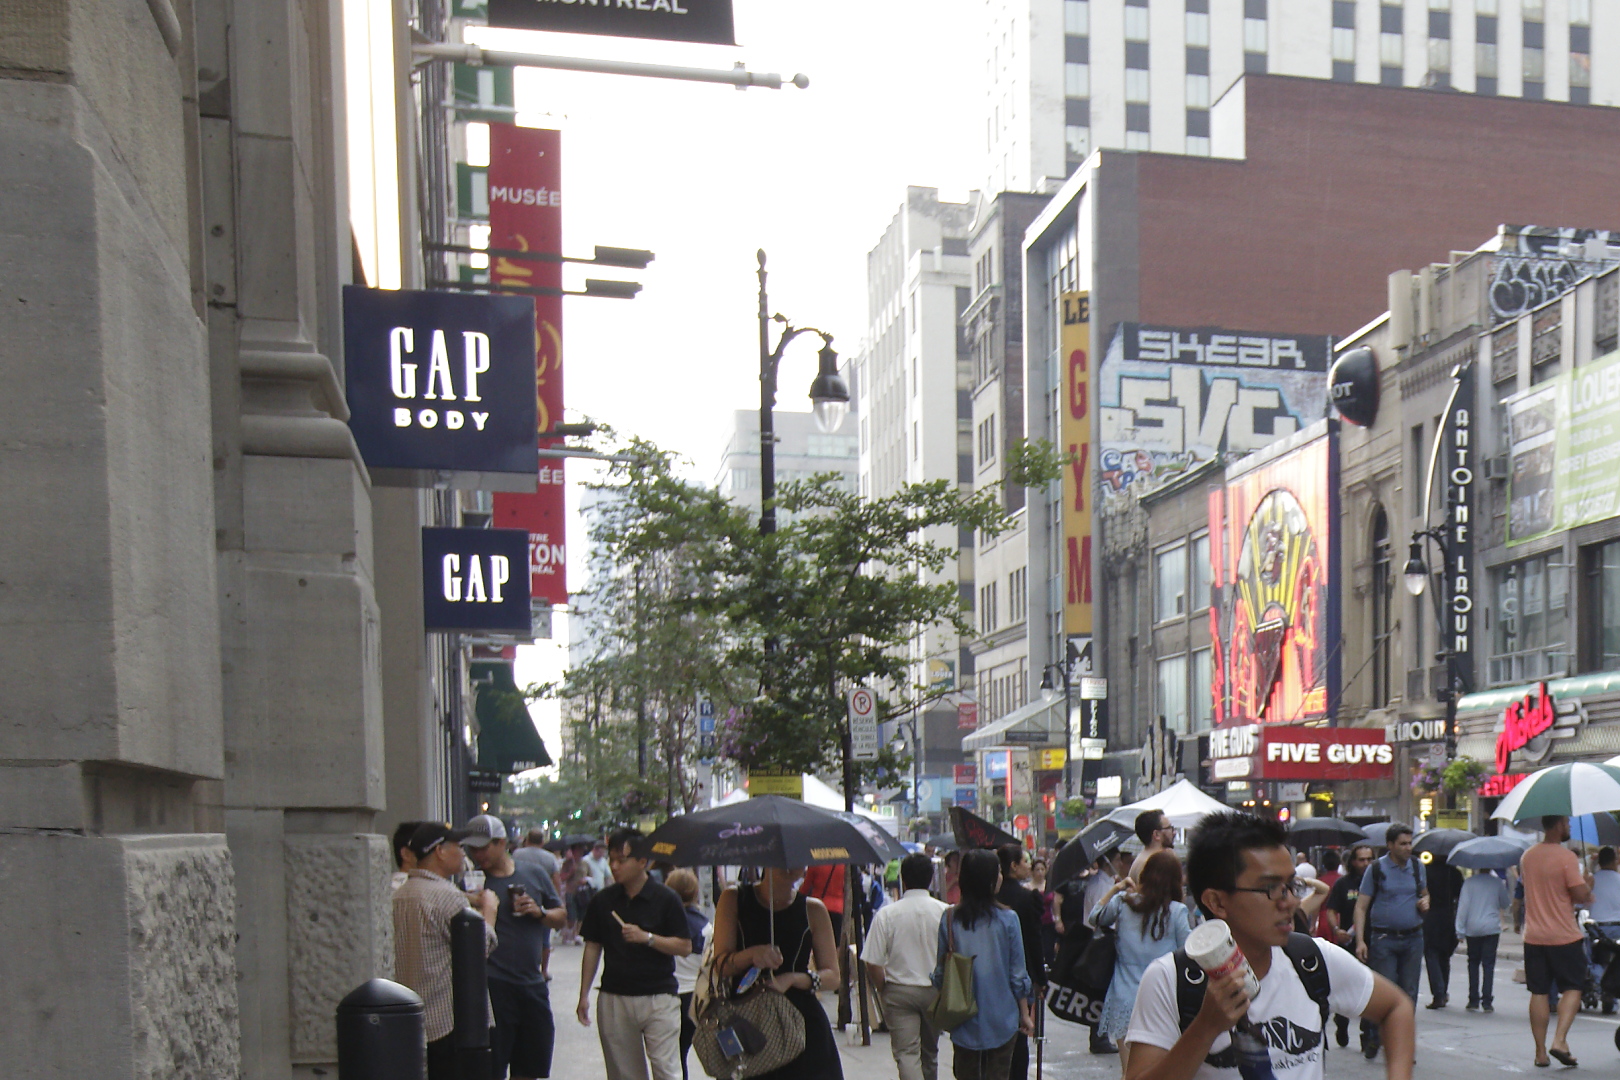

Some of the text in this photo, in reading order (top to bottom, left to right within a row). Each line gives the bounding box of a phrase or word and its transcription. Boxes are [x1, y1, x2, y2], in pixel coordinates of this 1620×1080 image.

[490, 186, 561, 207] MUSÉE
[1064, 298, 1090, 326] LE
[390, 326, 490, 402] GAP
[394, 407, 490, 431] BODY
[1067, 349, 1092, 604] GYM
[1451, 409, 1473, 543] ANTOINE
[443, 553, 510, 603] GAP
[1210, 724, 1259, 758] FIVE GUYS
[1495, 681, 1555, 774] Nickels
[1267, 742, 1393, 764] FIVE GUYS
